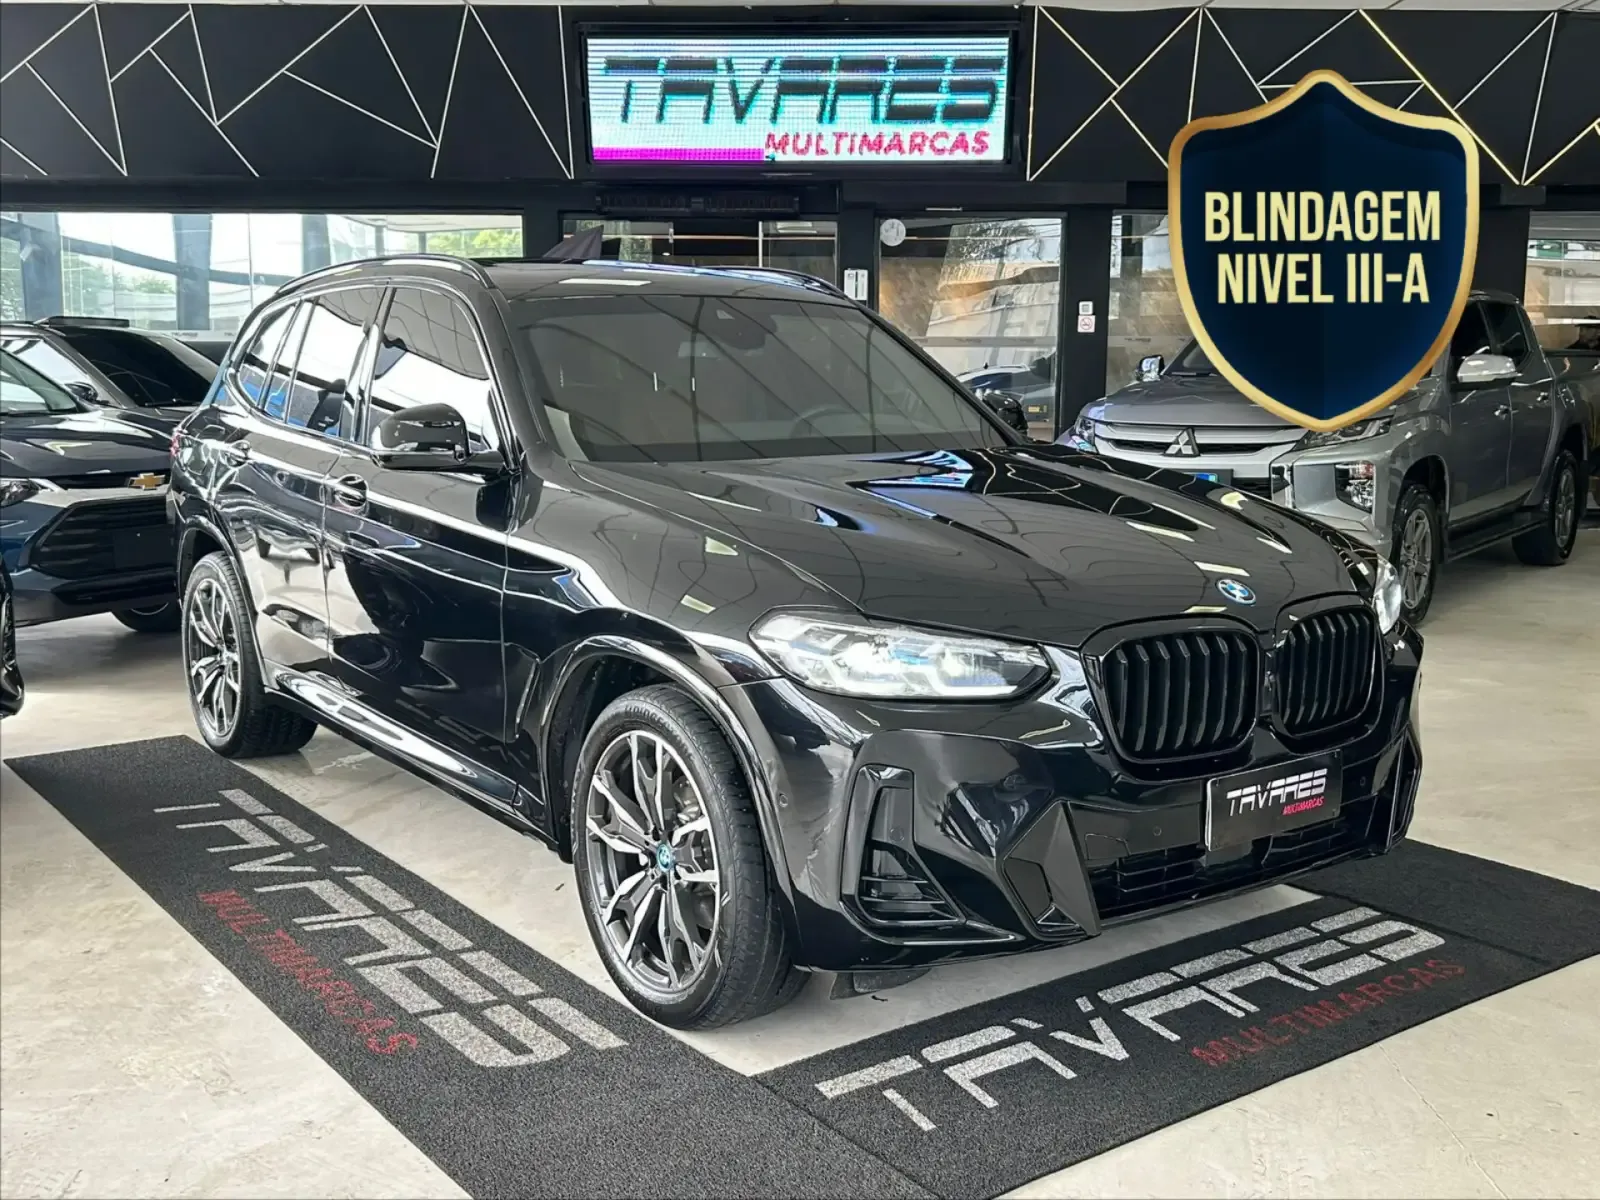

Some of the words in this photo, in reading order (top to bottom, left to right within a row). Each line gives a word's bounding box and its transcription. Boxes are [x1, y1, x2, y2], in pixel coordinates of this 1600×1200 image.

[604, 55, 1005, 124] TAVARES
[764, 130, 990, 157] MULTIMARCAS
[1226, 767, 1328, 817] TAVARES
[1190, 958, 1466, 1067] MULTIMARCAS
